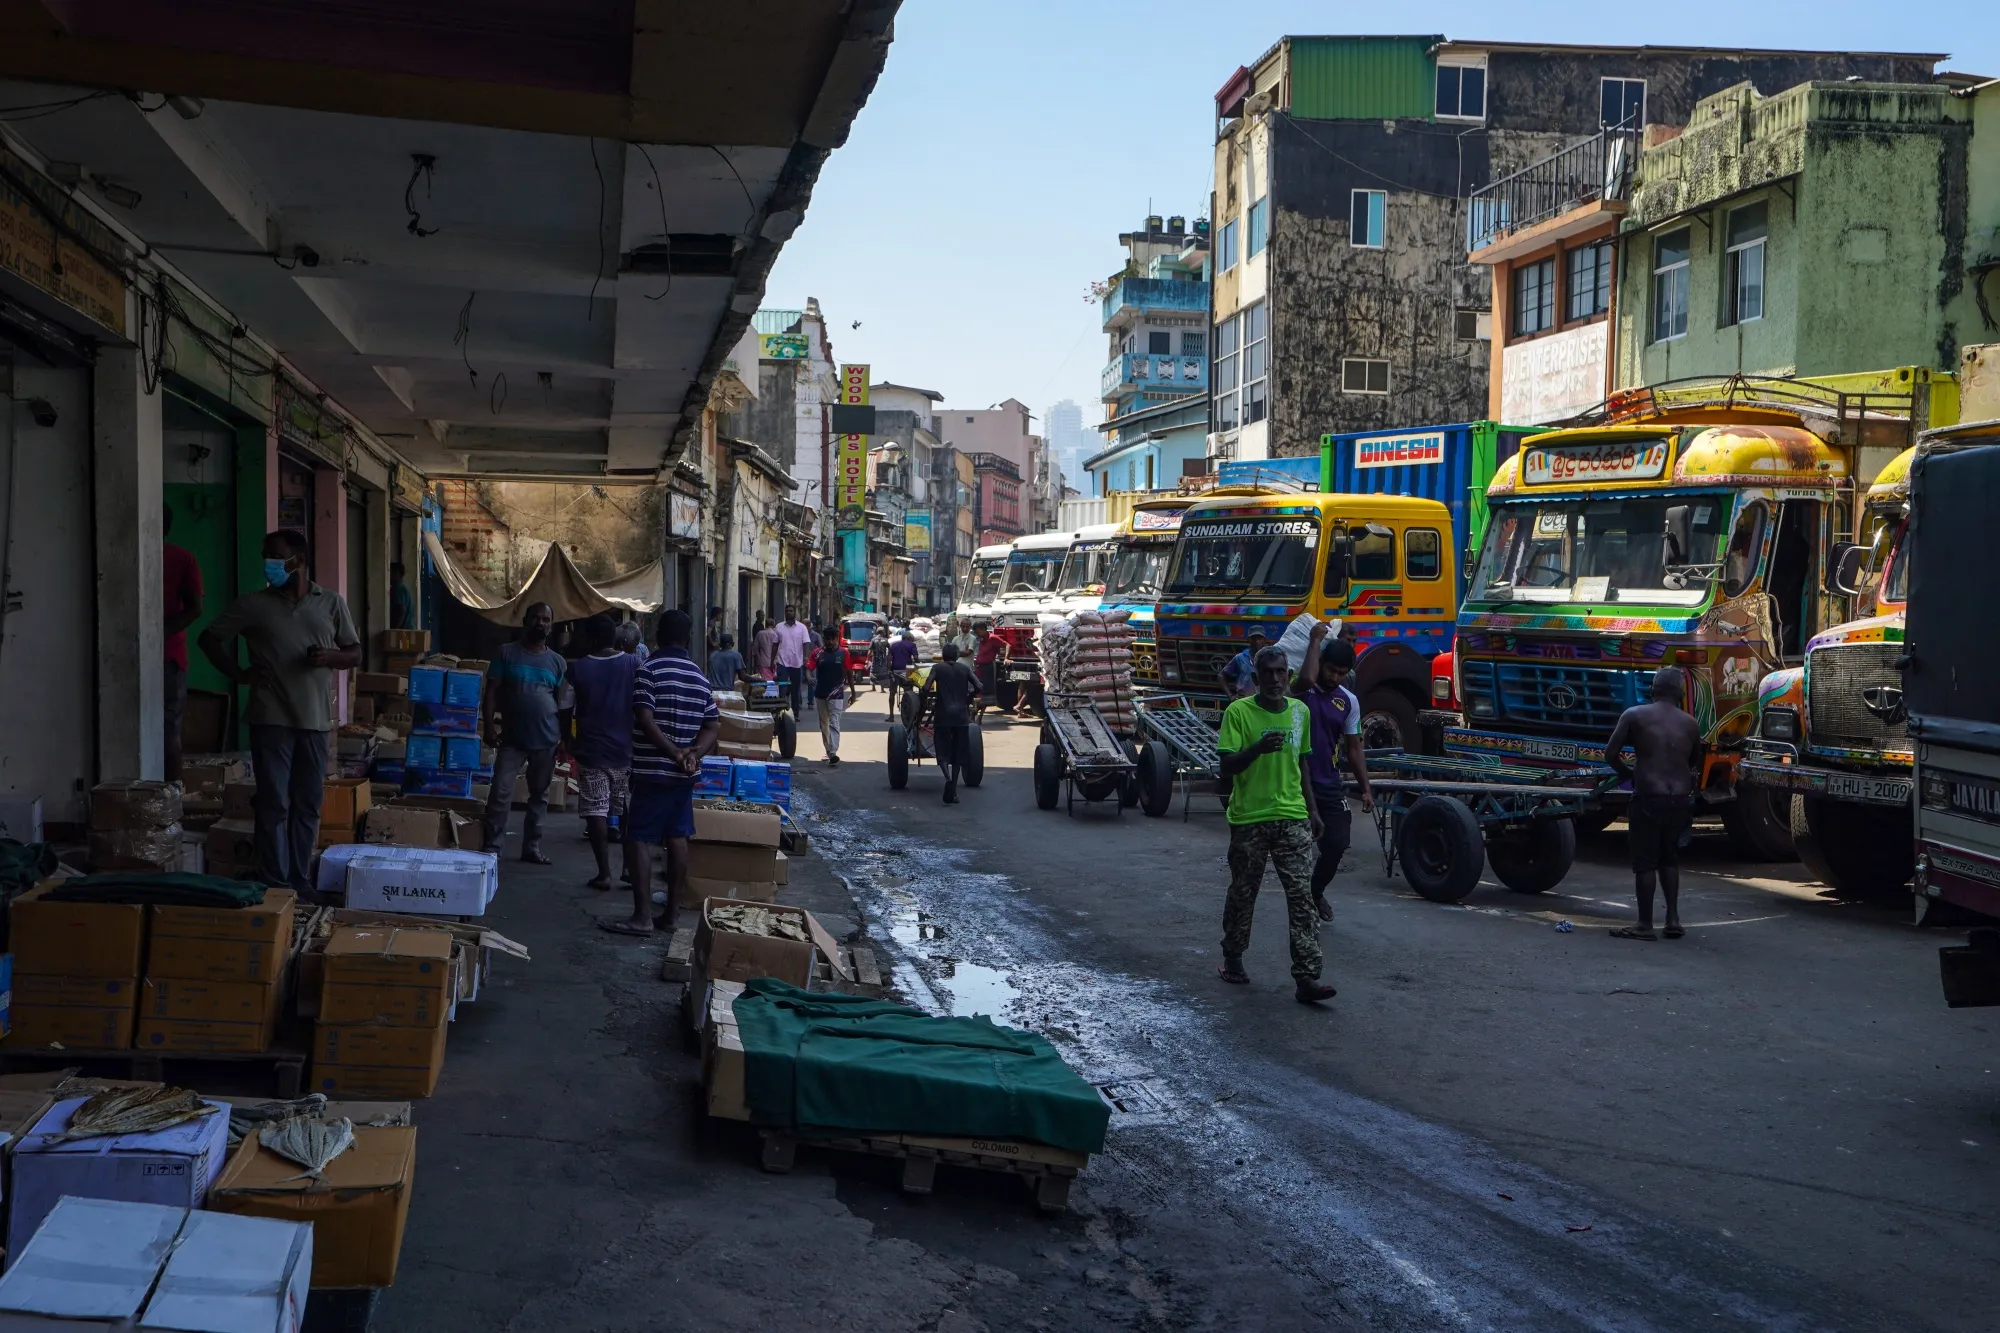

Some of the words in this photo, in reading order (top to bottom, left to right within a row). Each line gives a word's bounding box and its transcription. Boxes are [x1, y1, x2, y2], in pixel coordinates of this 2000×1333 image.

[1519, 330, 1605, 380] ENTERPRISES
[1360, 437, 1439, 463] DINESH
[846, 457, 860, 503] HOTEL
[1184, 523, 1252, 537] SUNDARAM
[1256, 521, 1311, 535] STORES
[1135, 630, 1153, 638] TATA
[1541, 644, 1576, 658] TATA
[1551, 744, 1574, 759] 5238
[1941, 856, 1974, 873] EXTRA
[382, 885, 400, 896] SM
[402, 886, 447, 899] LANKA
[971, 1140, 1019, 1155] COLOMBO
